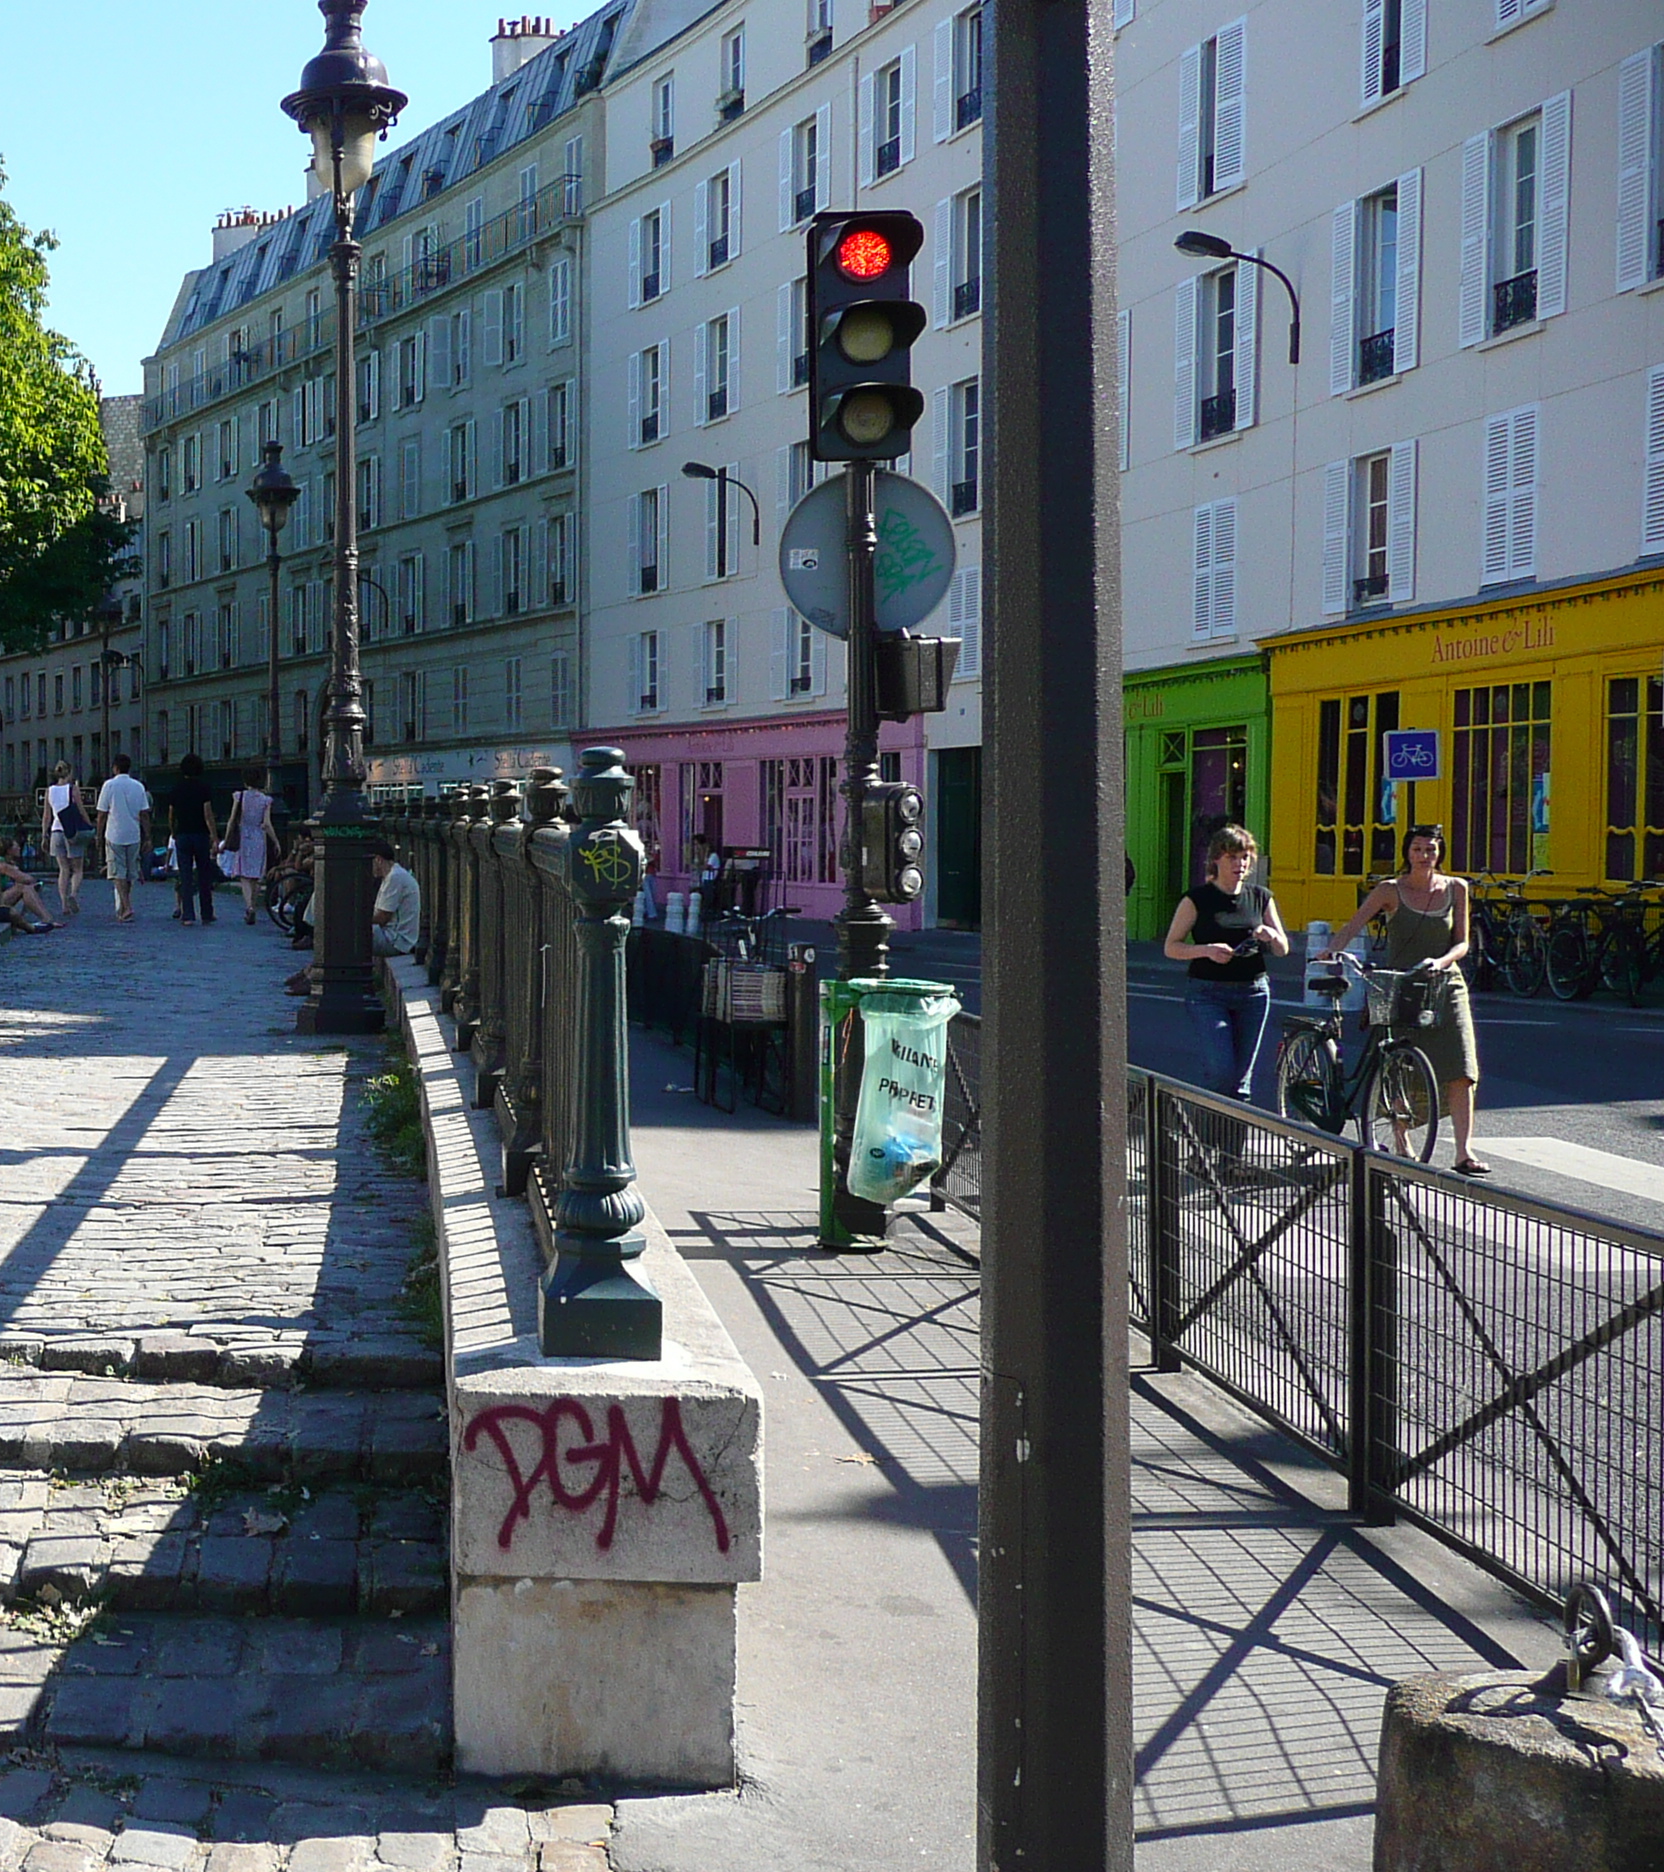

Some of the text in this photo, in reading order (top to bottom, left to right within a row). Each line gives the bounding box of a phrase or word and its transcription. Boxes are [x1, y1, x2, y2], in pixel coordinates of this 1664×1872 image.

[1431, 616, 1554, 663] Antoine & Lili
[1143, 693, 1164, 717] Lili
